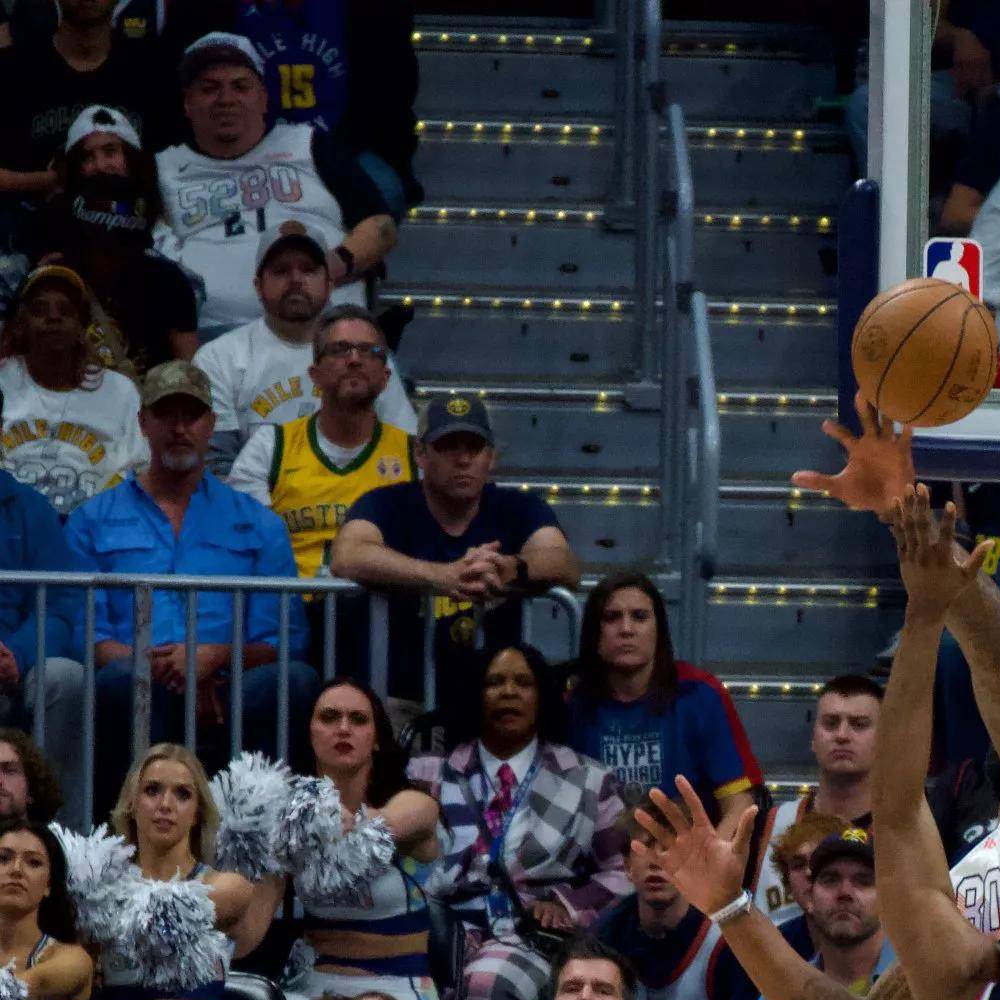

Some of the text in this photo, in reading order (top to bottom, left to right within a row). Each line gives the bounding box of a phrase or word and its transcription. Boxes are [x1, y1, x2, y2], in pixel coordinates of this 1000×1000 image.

[278, 64, 317, 109] 15
[178, 165, 303, 226] 5280
[249, 375, 303, 417] MILE
[604, 743, 661, 766] HYPE
